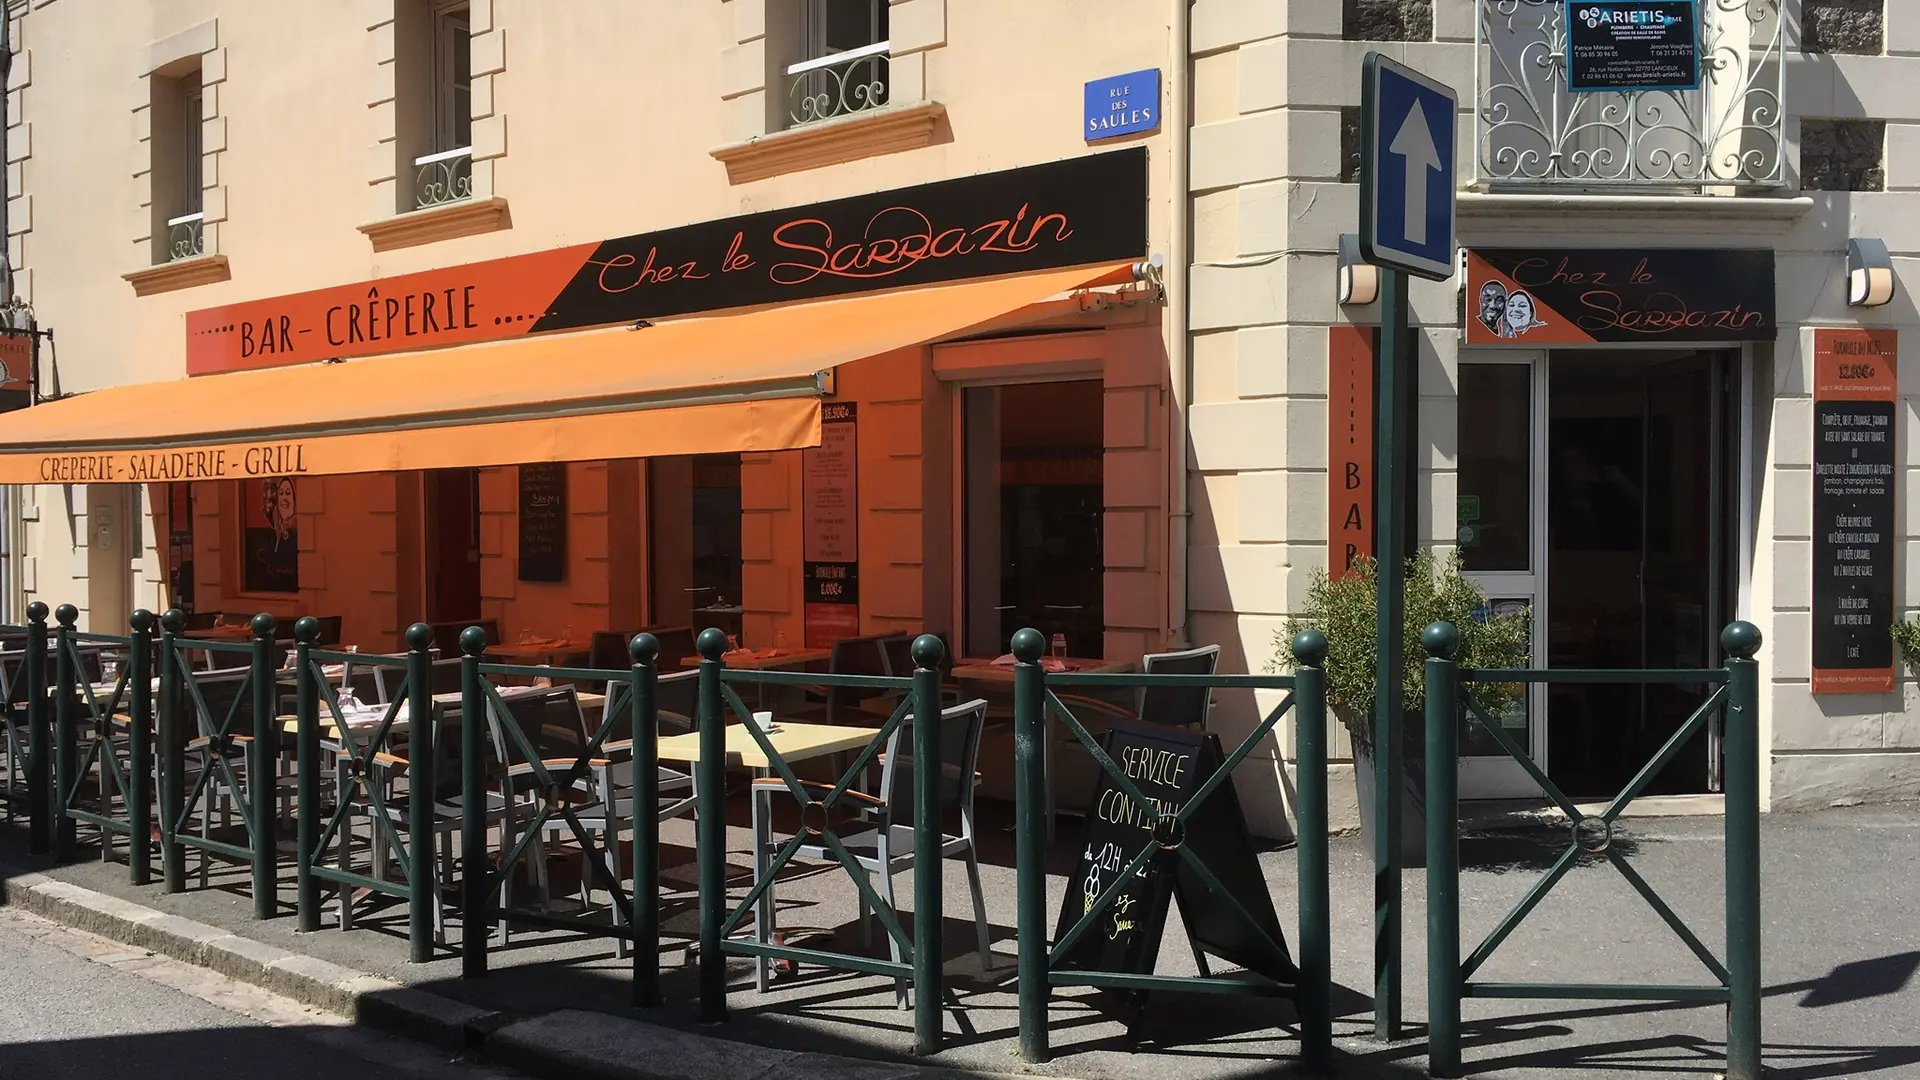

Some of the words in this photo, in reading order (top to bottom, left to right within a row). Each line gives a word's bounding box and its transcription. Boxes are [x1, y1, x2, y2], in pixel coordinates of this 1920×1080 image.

[1600, 10, 1665, 23] ARIETIS
[1110, 86, 1130, 98] RUE
[1111, 100, 1128, 111] DES
[1090, 108, 1151, 131] SAULES
[587, 246, 711, 293] Chez
[721, 231, 756, 273] le
[1511, 256, 1608, 288] Chez
[1629, 256, 1657, 285] le
[326, 286, 478, 347] CRÊPERIE
[40, 455, 114, 482] CREPERIE
[128, 449, 226, 481] SALADERIE
[244, 444, 308, 476] GRILL
[1122, 746, 1190, 789] SERVICE
[1095, 842, 1123, 872] 12H
